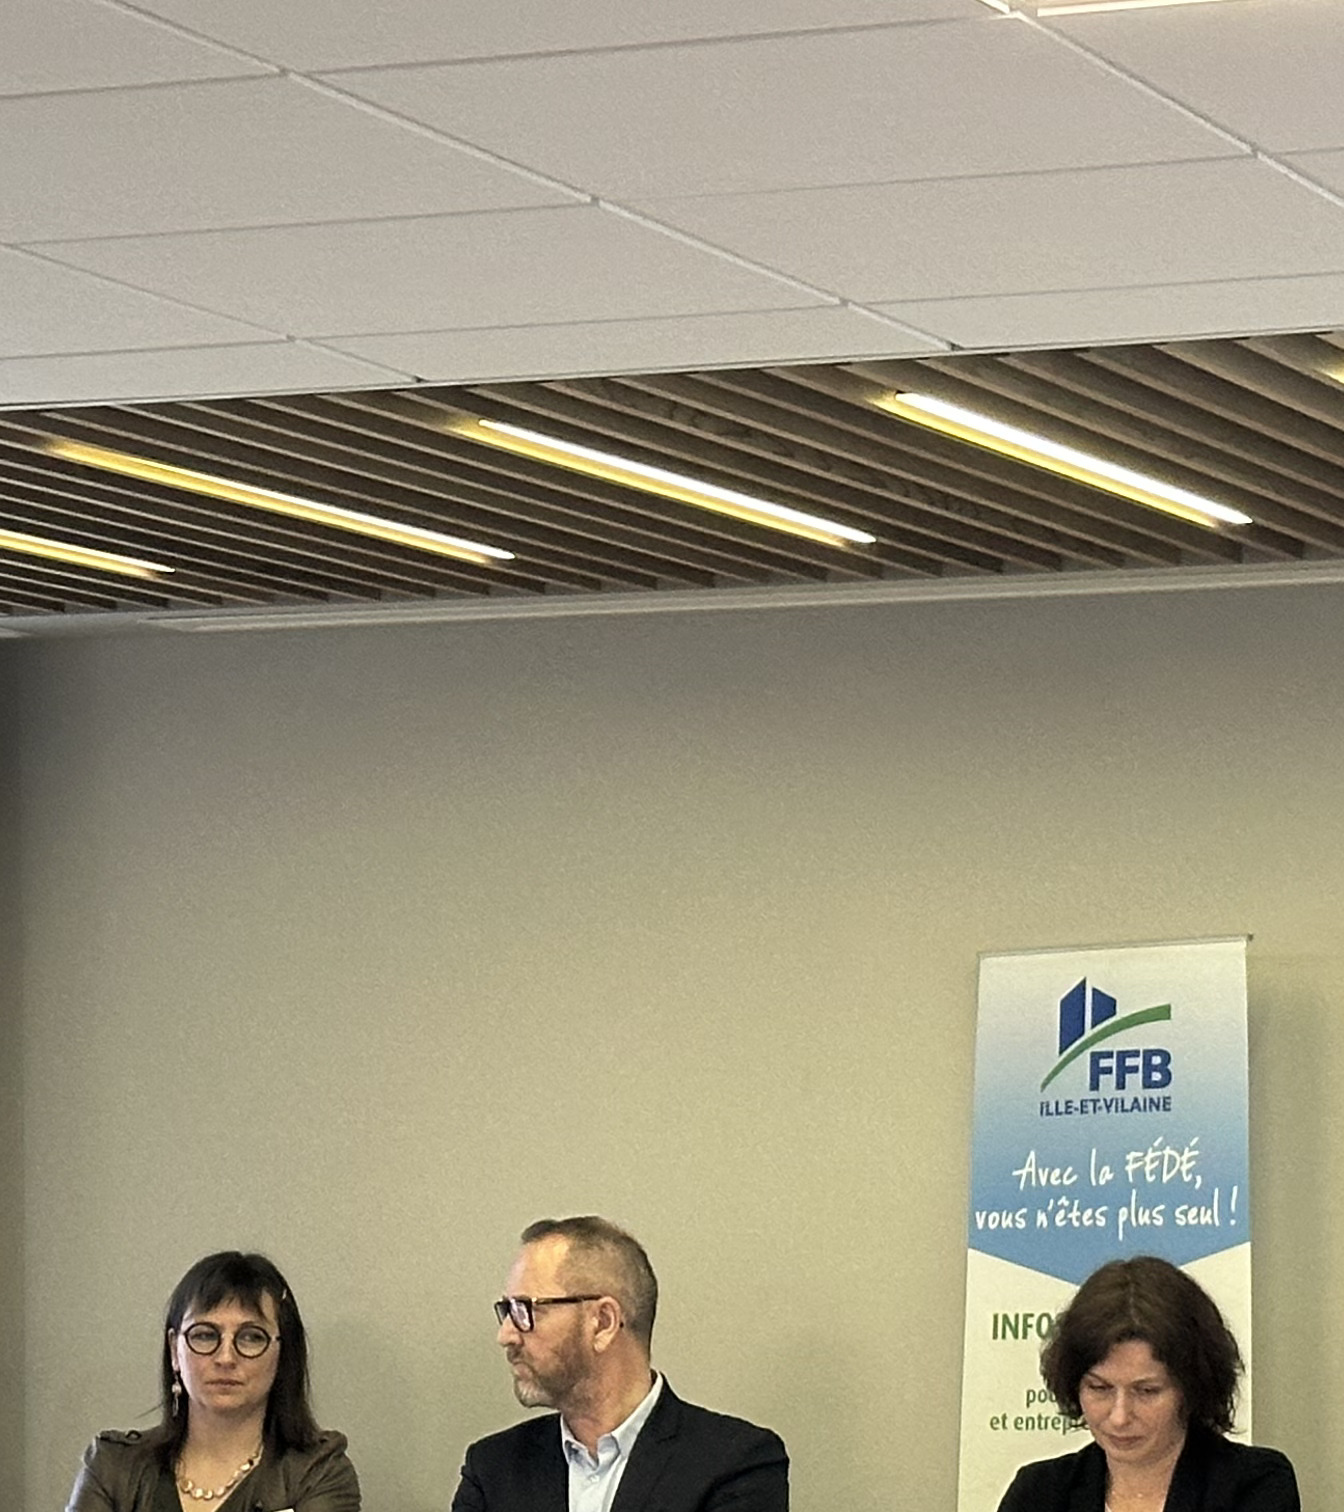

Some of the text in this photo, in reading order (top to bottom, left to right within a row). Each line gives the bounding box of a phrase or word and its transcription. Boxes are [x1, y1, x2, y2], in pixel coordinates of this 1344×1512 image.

[1088, 1048, 1173, 1091] FFB
[1039, 1096, 1173, 1117] ILLE-ET-VILAINE
[1012, 1136, 1203, 1191] Avec la FÉDÉ,
[975, 1208, 1028, 1230] vous
[1118, 1189, 1165, 1241] plus
[1174, 1187, 1220, 1227] seul
[992, 1313, 1056, 1340] INFO
[990, 1412, 1007, 1430] et
